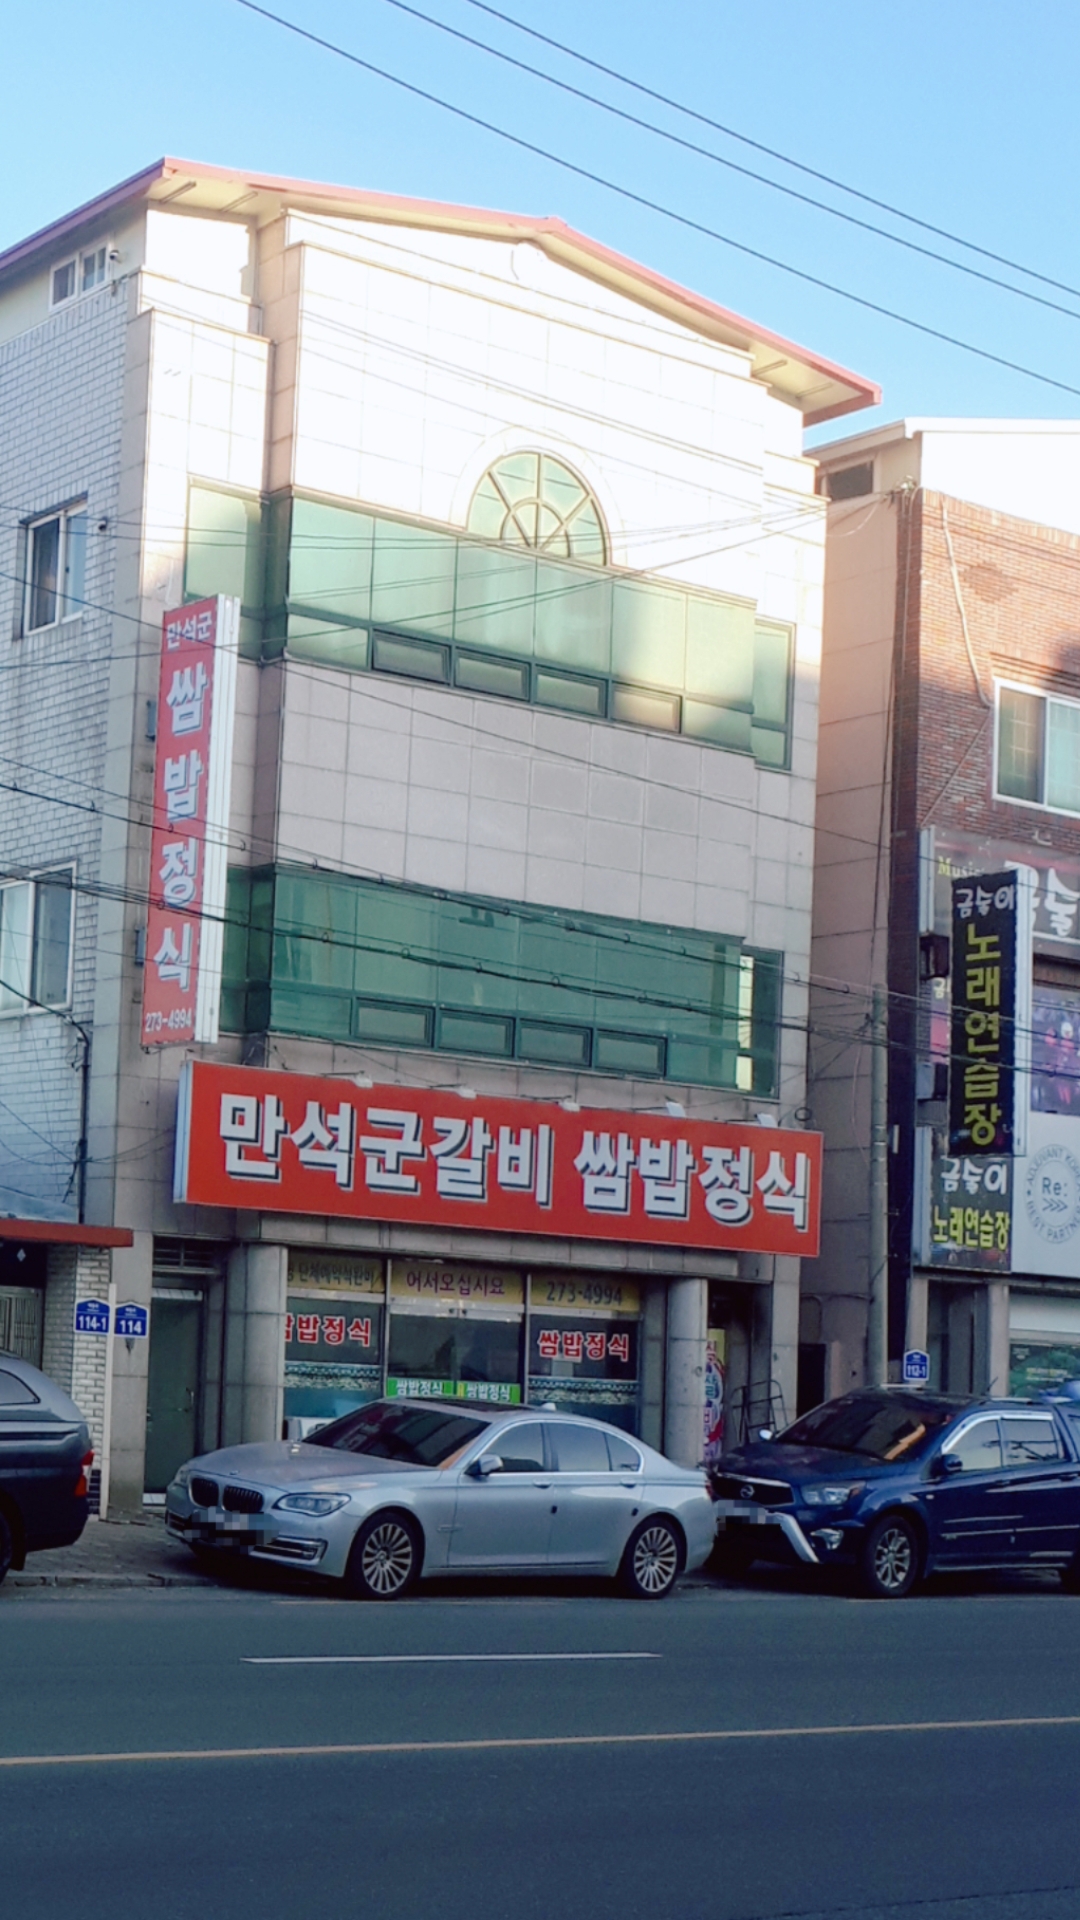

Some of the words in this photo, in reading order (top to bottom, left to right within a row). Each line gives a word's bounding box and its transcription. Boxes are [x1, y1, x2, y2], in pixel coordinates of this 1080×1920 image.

[166, 610, 213, 652] 만석군
[153, 661, 209, 993] 쌈밥정식
[145, 1008, 193, 1033] 273-4994
[964, 922, 1002, 1146] 노래연습장
[219, 1092, 556, 1212] 만석군갈비
[573, 1130, 811, 1234] 쌈밥정식
[933, 1204, 1011, 1251] 노래연습장
[406, 1270, 505, 1297] 어서오십시요
[546, 1280, 622, 1306] 273-4994
[78, 1315, 107, 1331] 114-1
[119, 1319, 142, 1334] 114
[537, 1330, 629, 1362] 쌈밥정식
[396, 1379, 443, 1395] 쌈밥정식
[467, 1381, 510, 1401] 쌈밥정식
